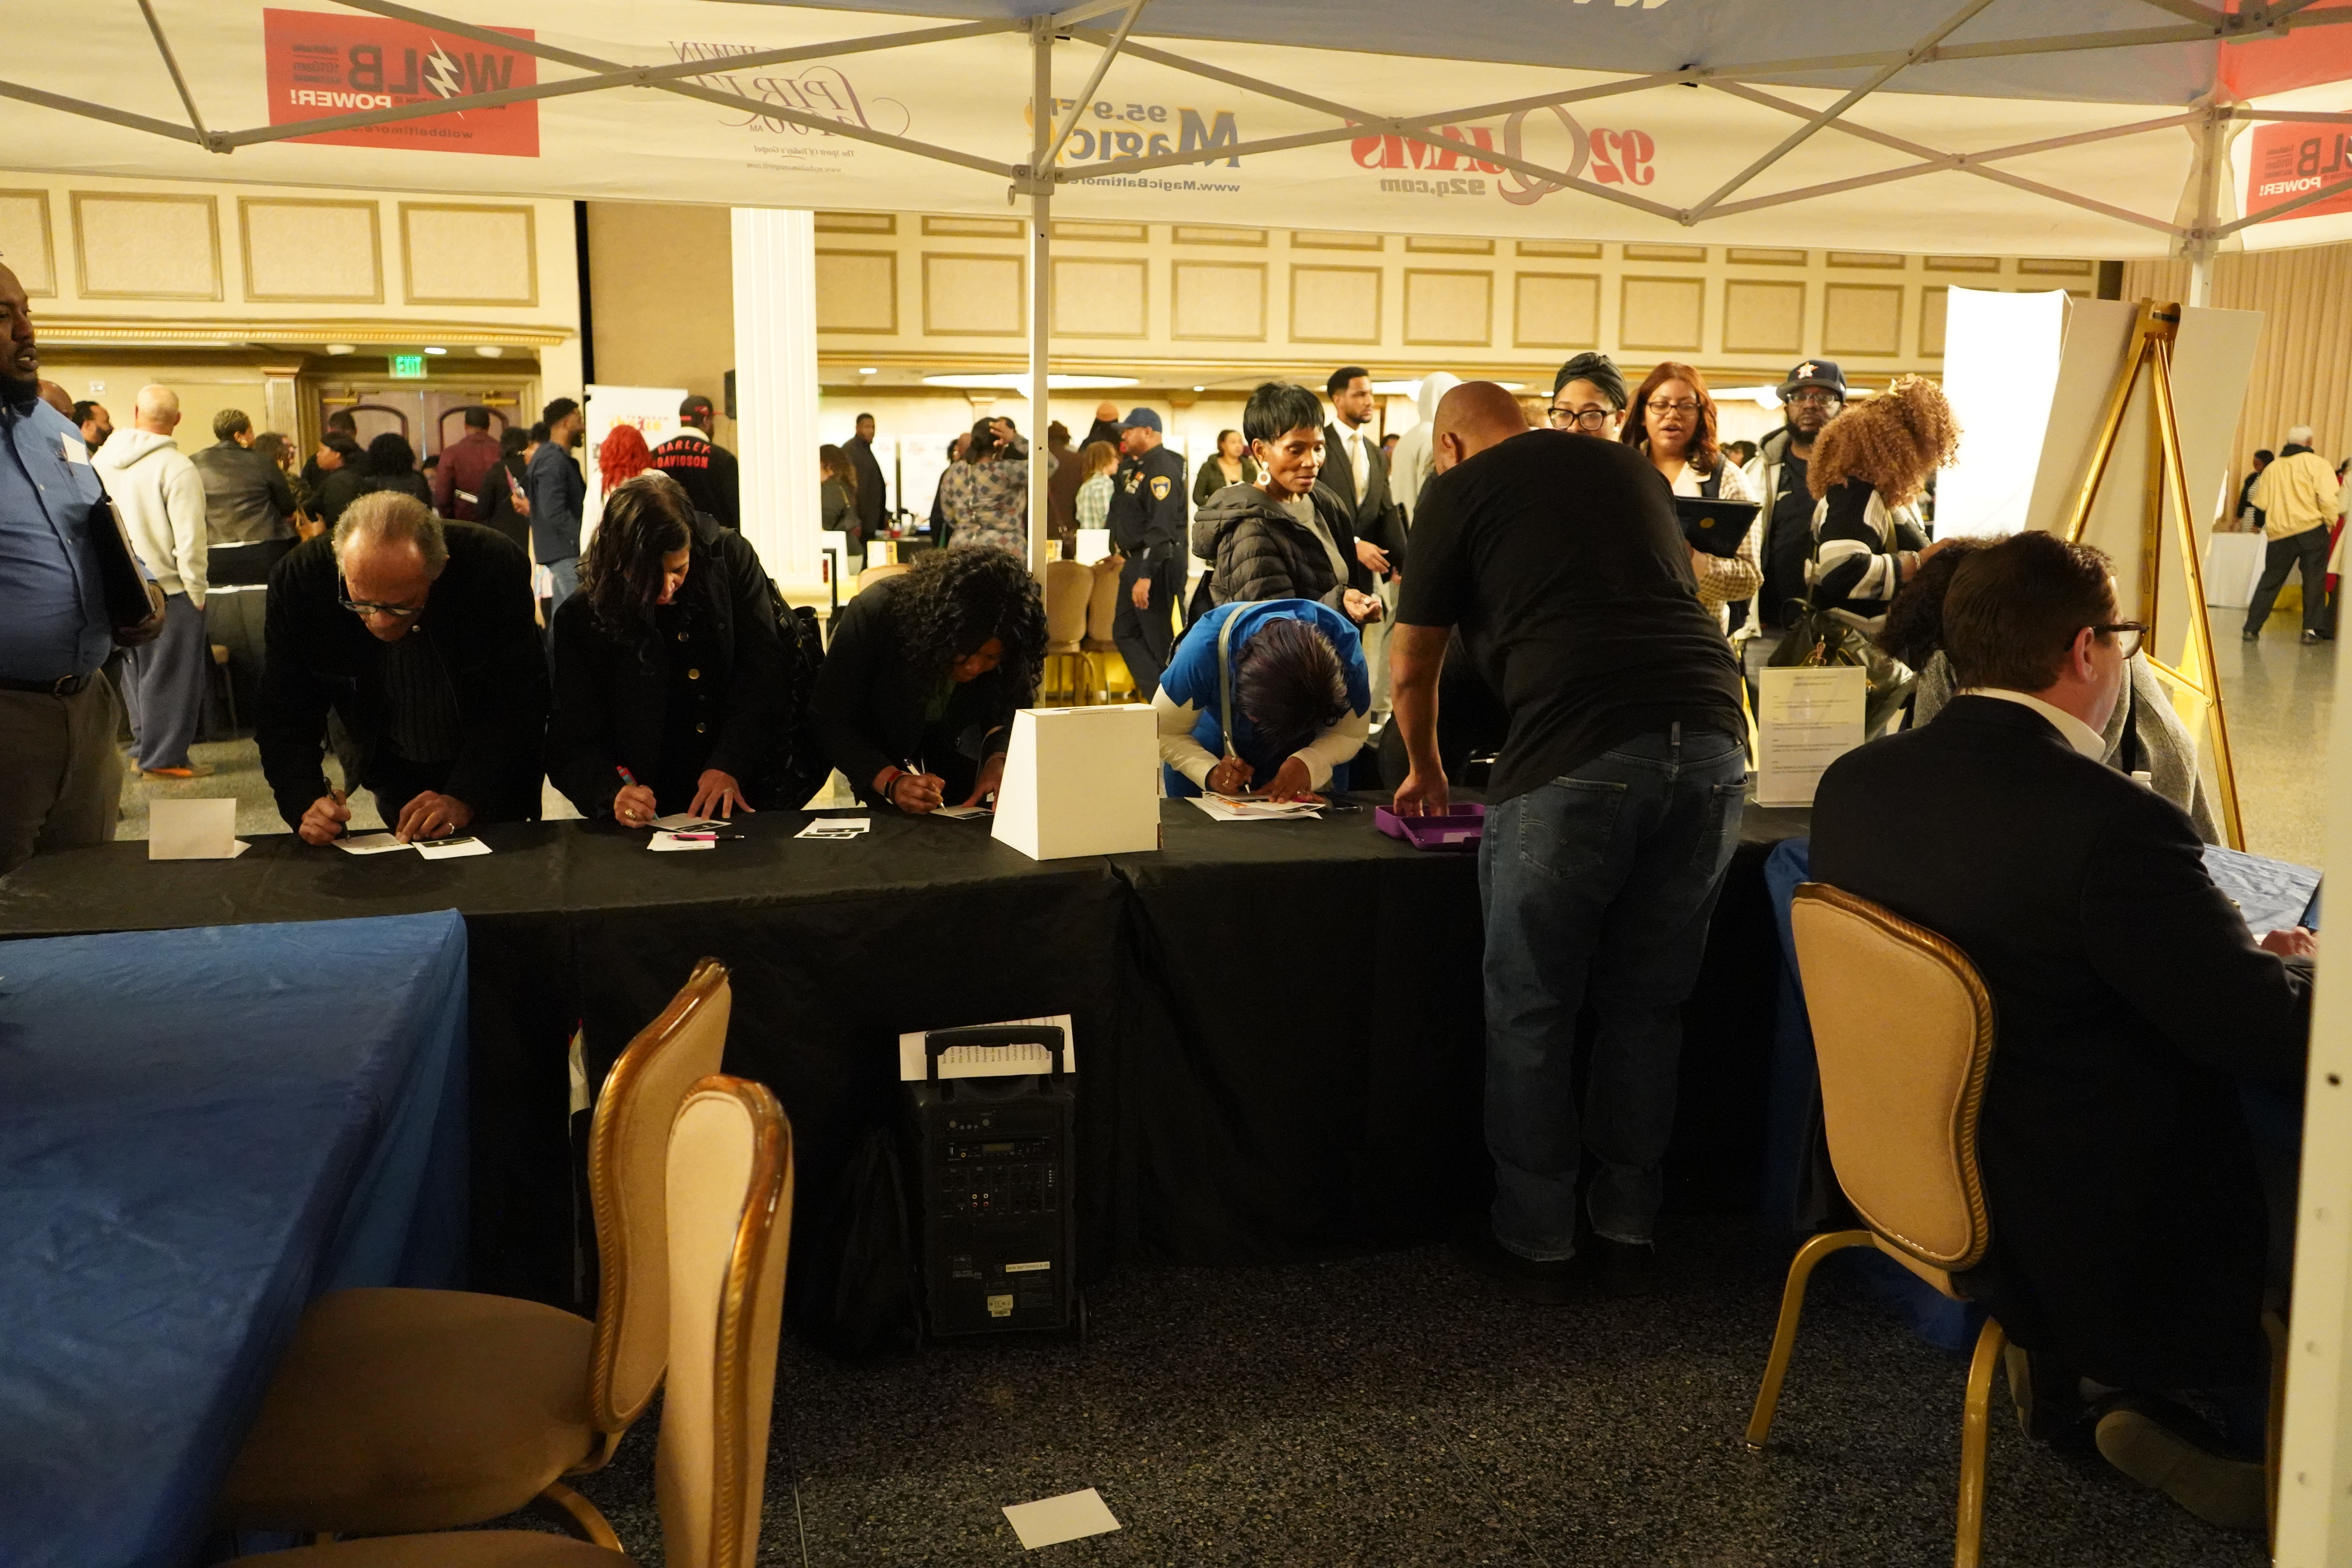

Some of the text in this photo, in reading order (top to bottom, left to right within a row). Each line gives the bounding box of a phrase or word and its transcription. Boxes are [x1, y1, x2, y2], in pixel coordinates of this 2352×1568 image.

[396, 356, 422, 377] EXIT
[657, 439, 711, 454] HARLEY
[657, 455, 709, 469] DAVIDSON
